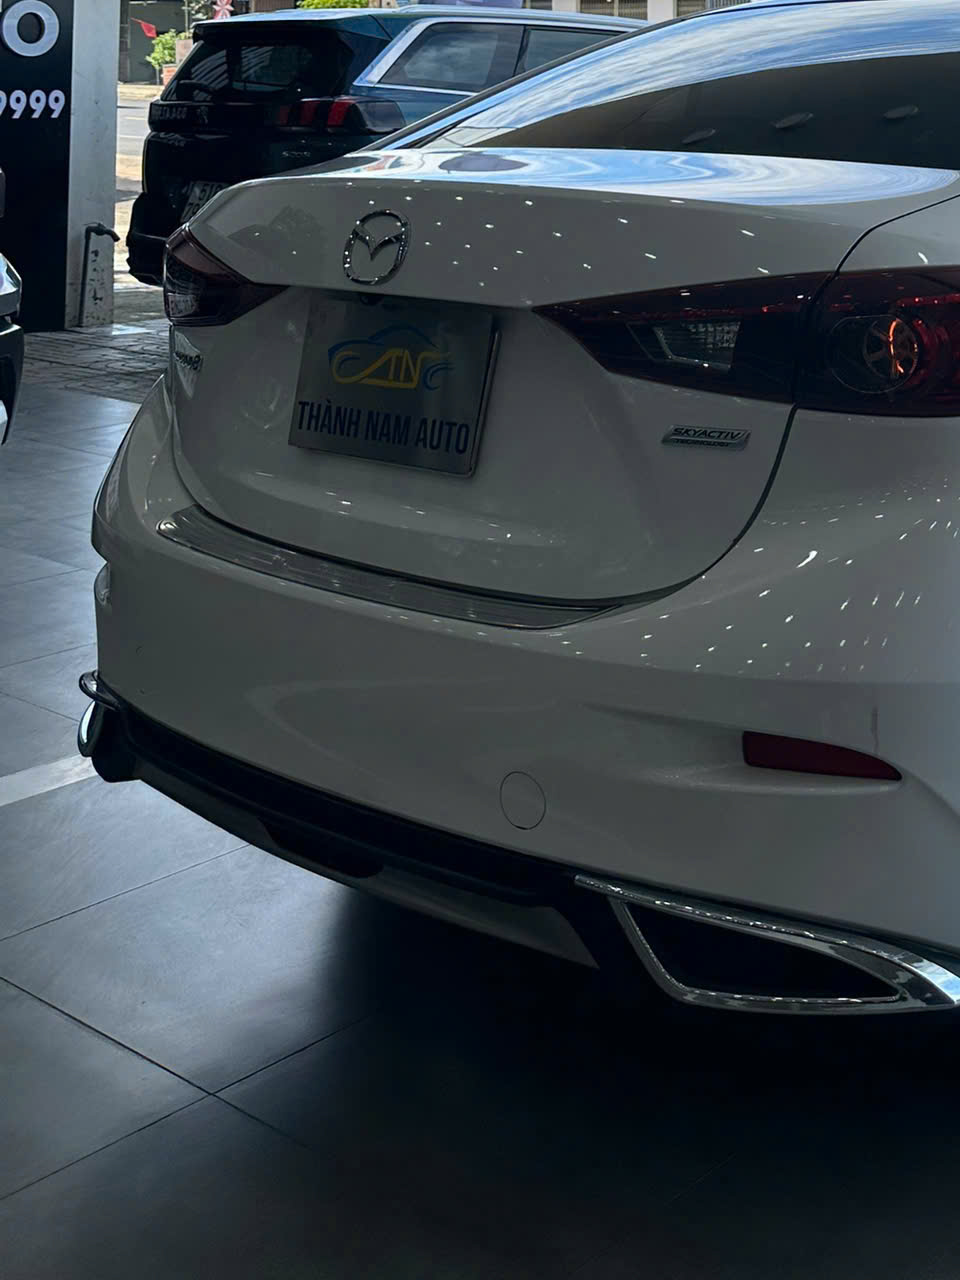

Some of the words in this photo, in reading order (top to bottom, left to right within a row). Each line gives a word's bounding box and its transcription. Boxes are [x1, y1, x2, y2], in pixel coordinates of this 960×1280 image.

[298, 399, 362, 439] THÀNH
[364, 410, 412, 447] NAM
[415, 417, 471, 455] AUTO
[671, 427, 742, 440] SKYACTIV
